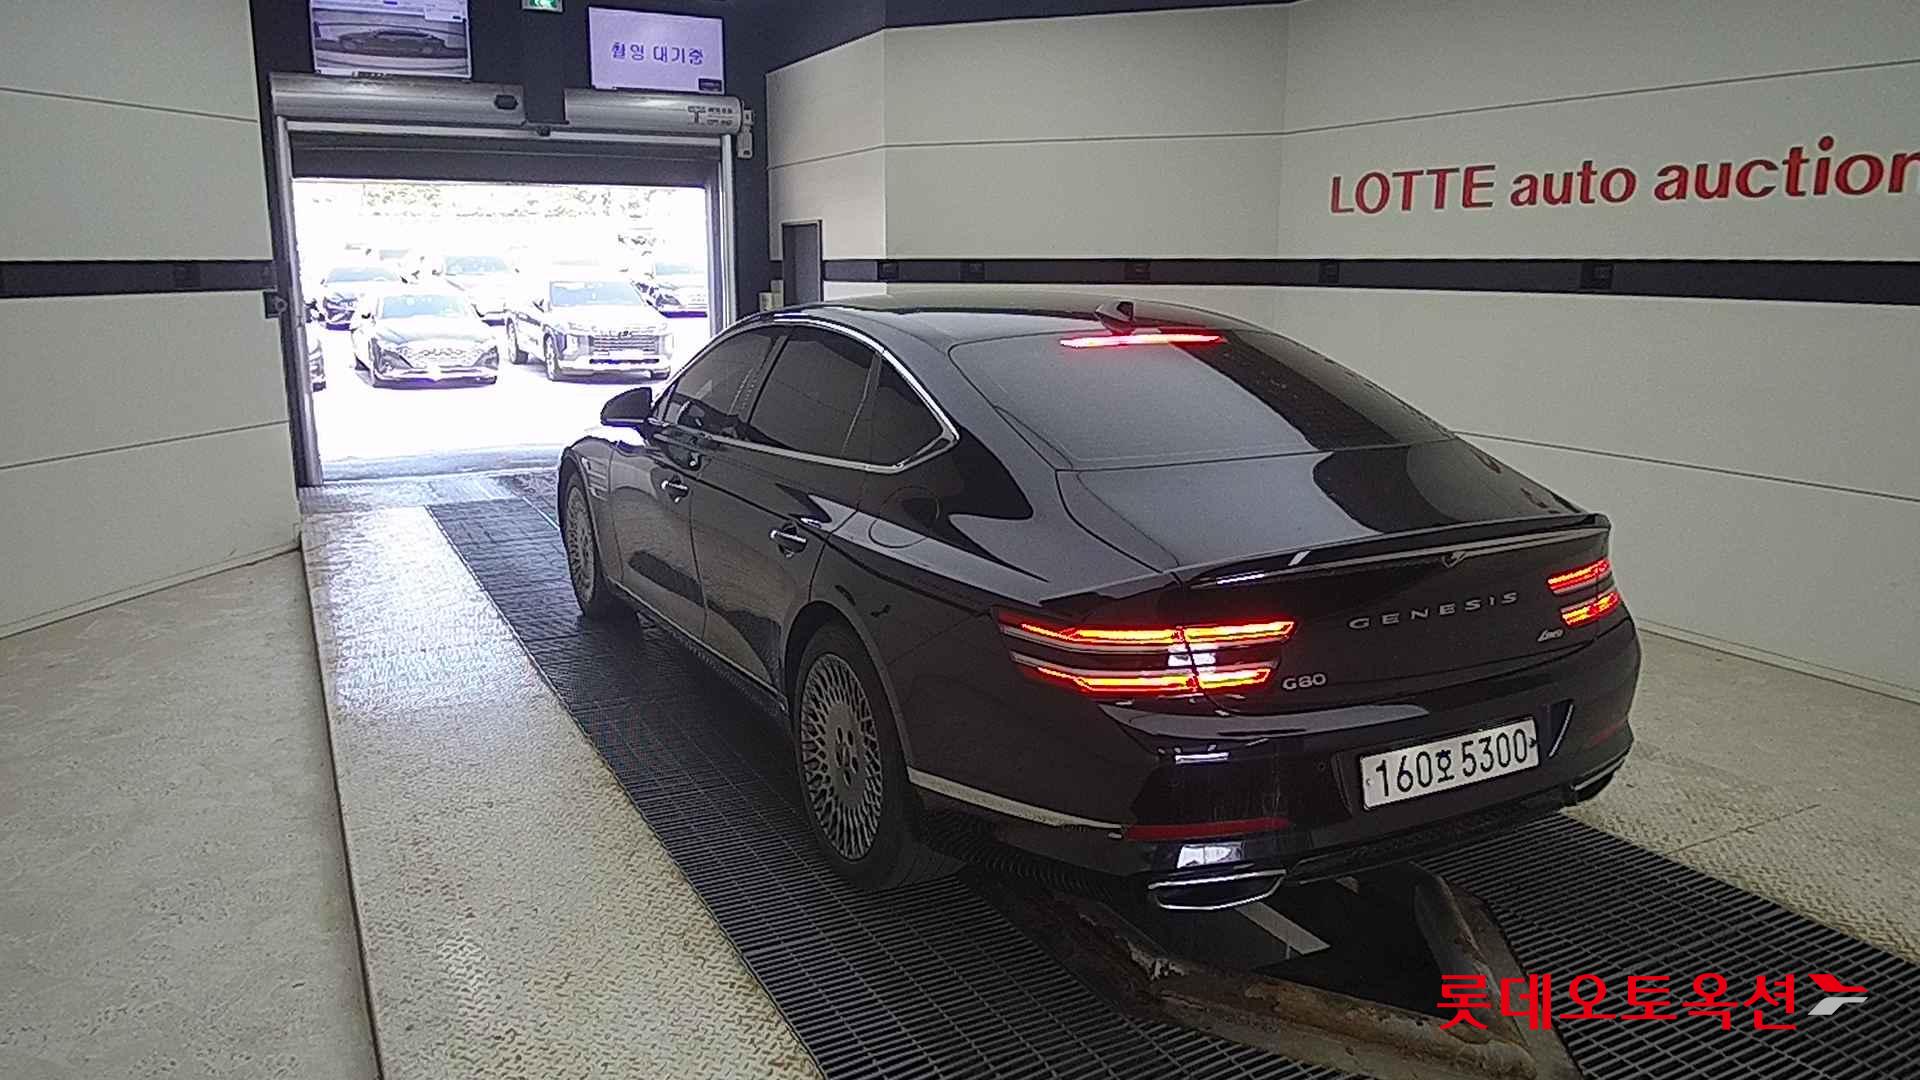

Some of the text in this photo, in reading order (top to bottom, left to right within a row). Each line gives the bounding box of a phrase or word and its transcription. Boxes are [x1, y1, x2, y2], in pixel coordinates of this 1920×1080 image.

[1331, 164, 1496, 214] LOTTE
[1510, 160, 1637, 207] auto
[1348, 592, 1518, 630] GENESIS
[1282, 673, 1327, 690] G80
